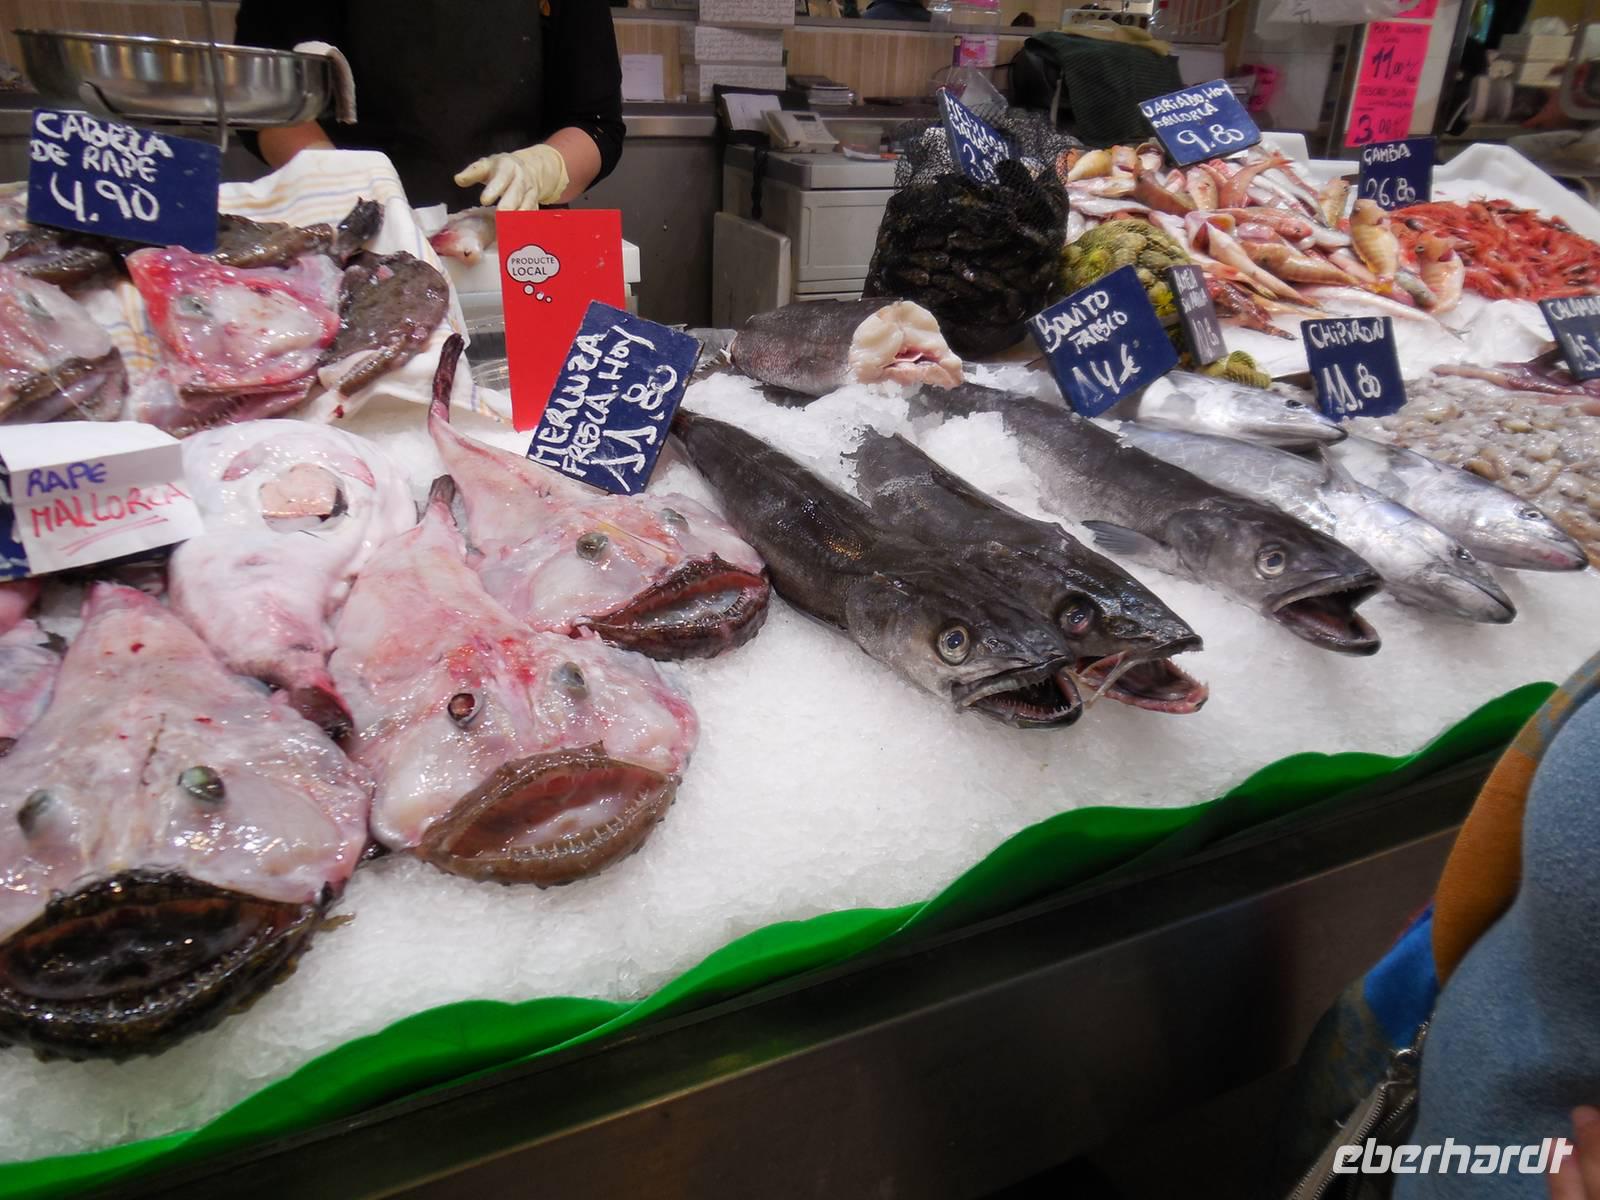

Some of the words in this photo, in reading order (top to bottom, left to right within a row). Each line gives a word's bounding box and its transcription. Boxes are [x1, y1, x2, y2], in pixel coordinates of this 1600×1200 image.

[1177, 124, 1245, 153] 9.80
[1363, 143, 1411, 165] GAMBA
[30, 139, 70, 167] DE
[82, 146, 158, 183] RAPE
[51, 172, 160, 223] 4.90
[511, 256, 556, 265] PRODUCTE
[512, 266, 547, 277] LOCAL
[1034, 290, 1110, 354] BONITO
[1309, 317, 1385, 349] CHIPIRON
[527, 331, 609, 467] MERLUZA
[27, 462, 108, 497] RAPE
[30, 481, 192, 538] MALLORCA
